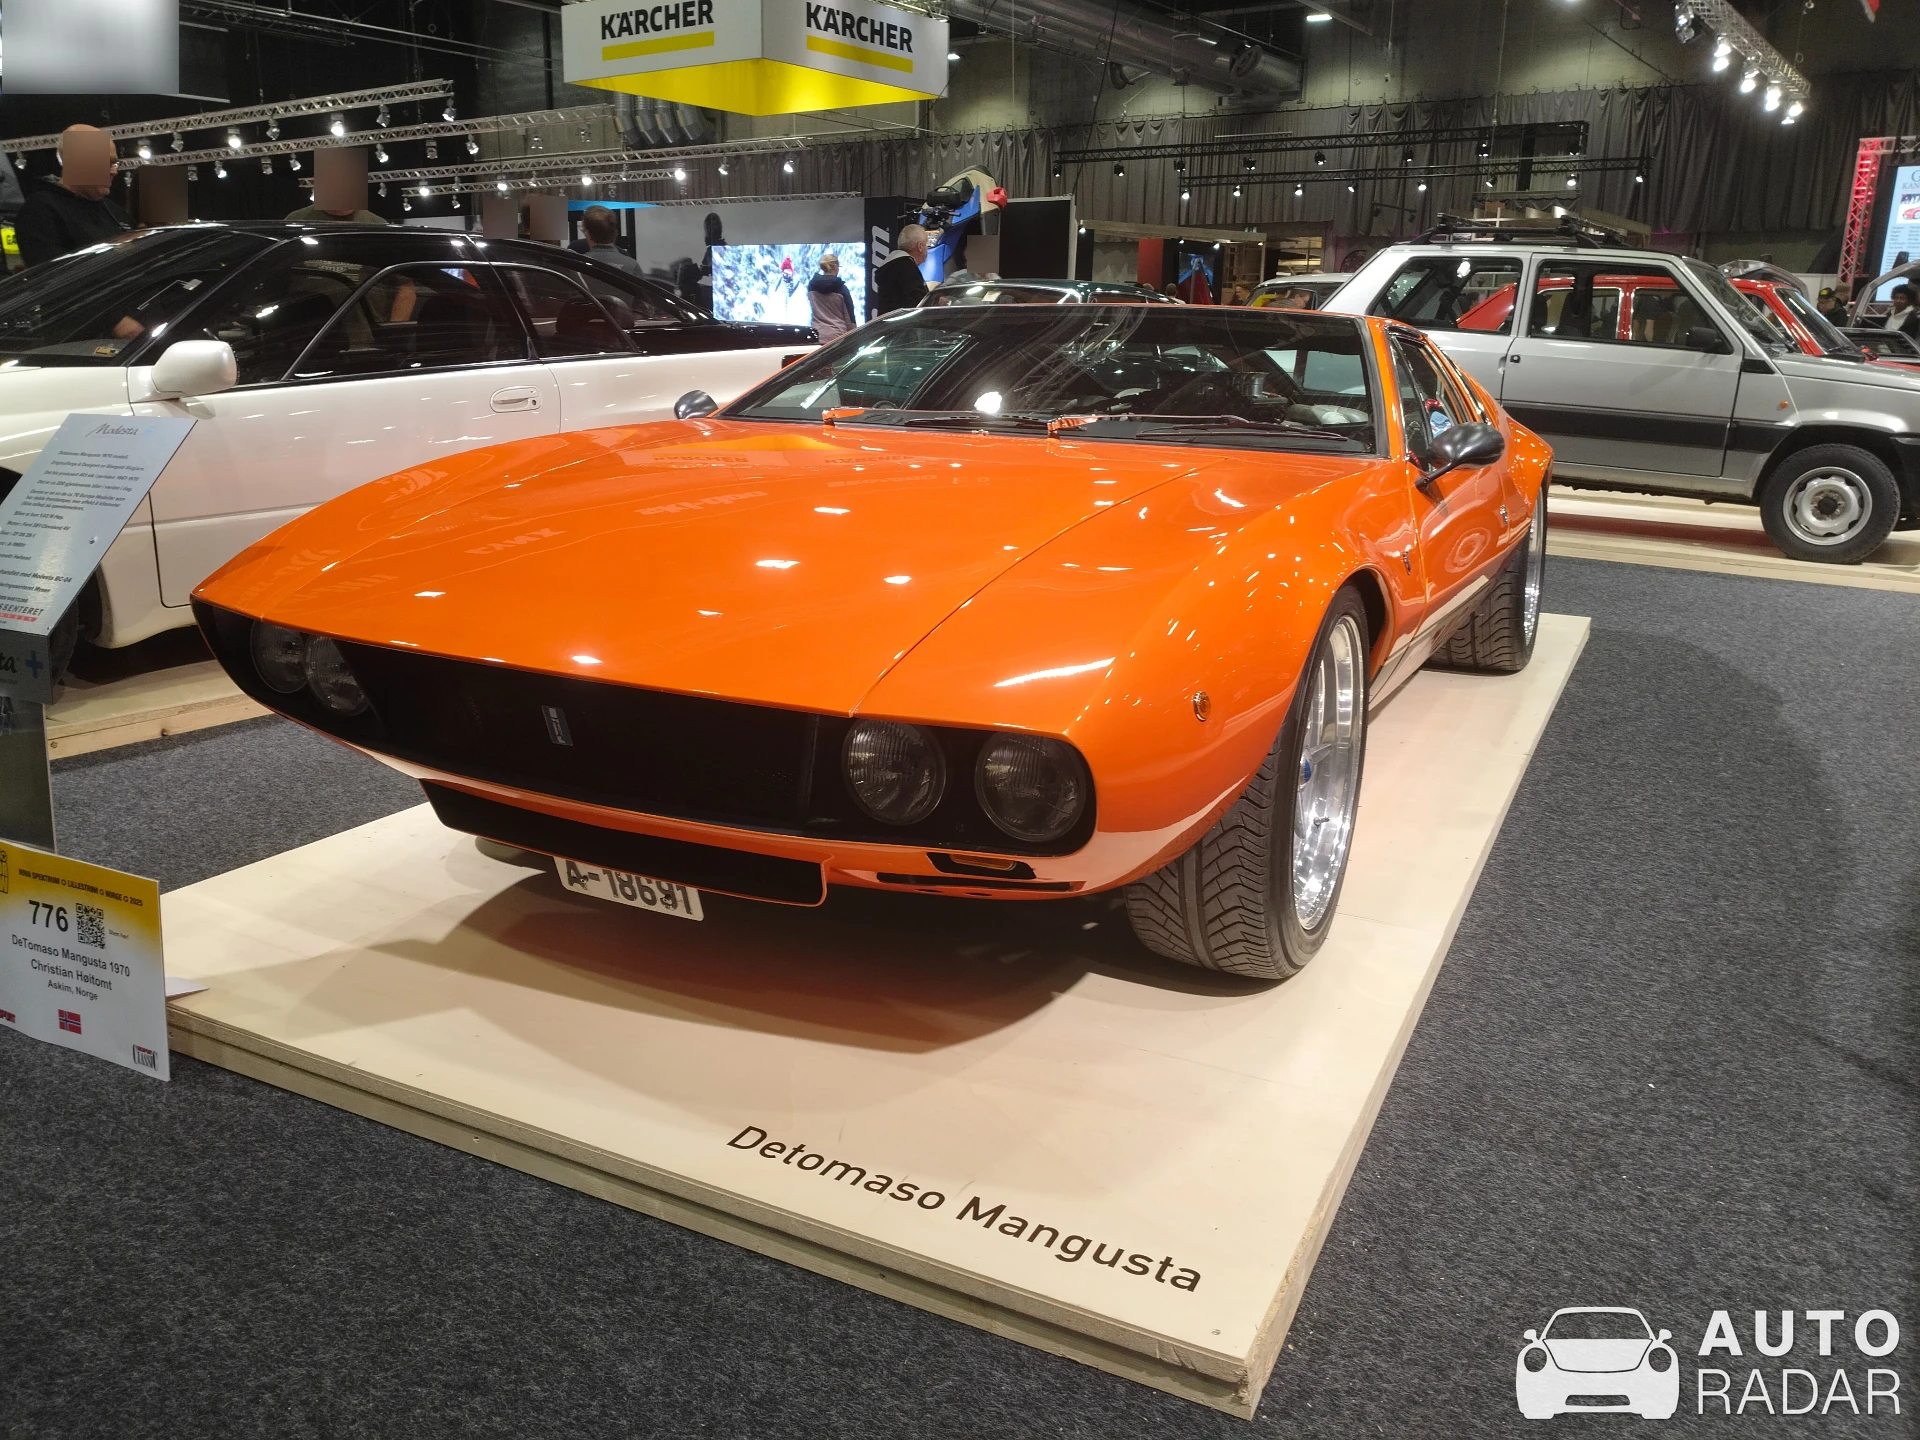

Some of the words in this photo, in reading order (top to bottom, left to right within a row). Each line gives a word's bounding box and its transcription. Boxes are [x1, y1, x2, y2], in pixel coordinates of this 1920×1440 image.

[601, 0, 714, 40] KÄRCHER
[807, 2, 914, 52] KÄRCHER
[32, 872, 60, 884] SPEKTRUM
[68, 880, 98, 894] LILLESTRØM
[106, 891, 122, 901] NORGE
[130, 896, 143, 906] 2025
[565, 859, 693, 915] A-18691
[29, 900, 68, 932] 776
[12, 934, 59, 957] DeTomaso
[62, 948, 107, 970] Mangusta
[110, 962, 130, 977] 1970
[31, 959, 74, 980] Christian
[76, 969, 112, 990] Høitomt
[48, 980, 74, 995] Askim,
[76, 986, 98, 1001] Norge
[726, 1125, 946, 1211] Detomaso
[956, 1196, 1202, 1292] Mangusta
